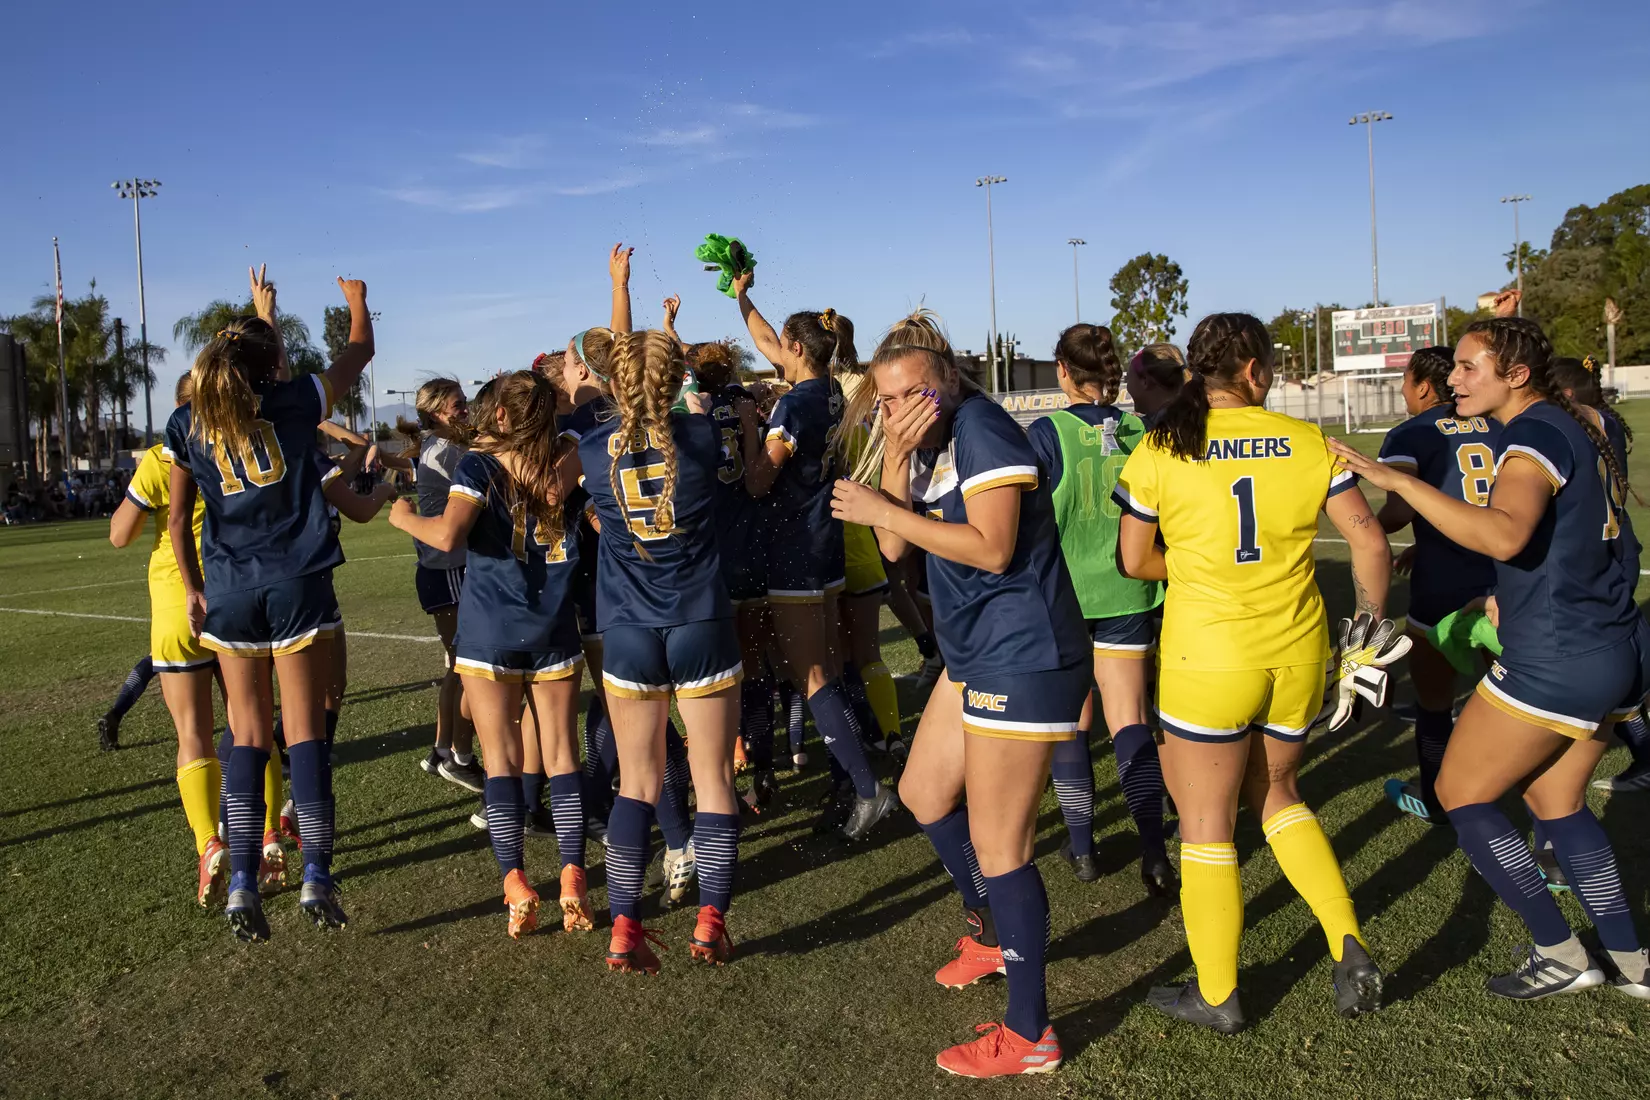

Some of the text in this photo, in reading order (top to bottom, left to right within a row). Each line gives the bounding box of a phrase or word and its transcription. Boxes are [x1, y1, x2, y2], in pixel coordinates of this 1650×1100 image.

[1001, 393, 1073, 412] ANCERS
[209, 418, 287, 496] 10
[1192, 437, 1292, 461] ANCERS
[1456, 443, 1496, 507] 8
[620, 462, 676, 541] 5
[1231, 476, 1262, 565] 1
[967, 689, 1008, 712] WAC
